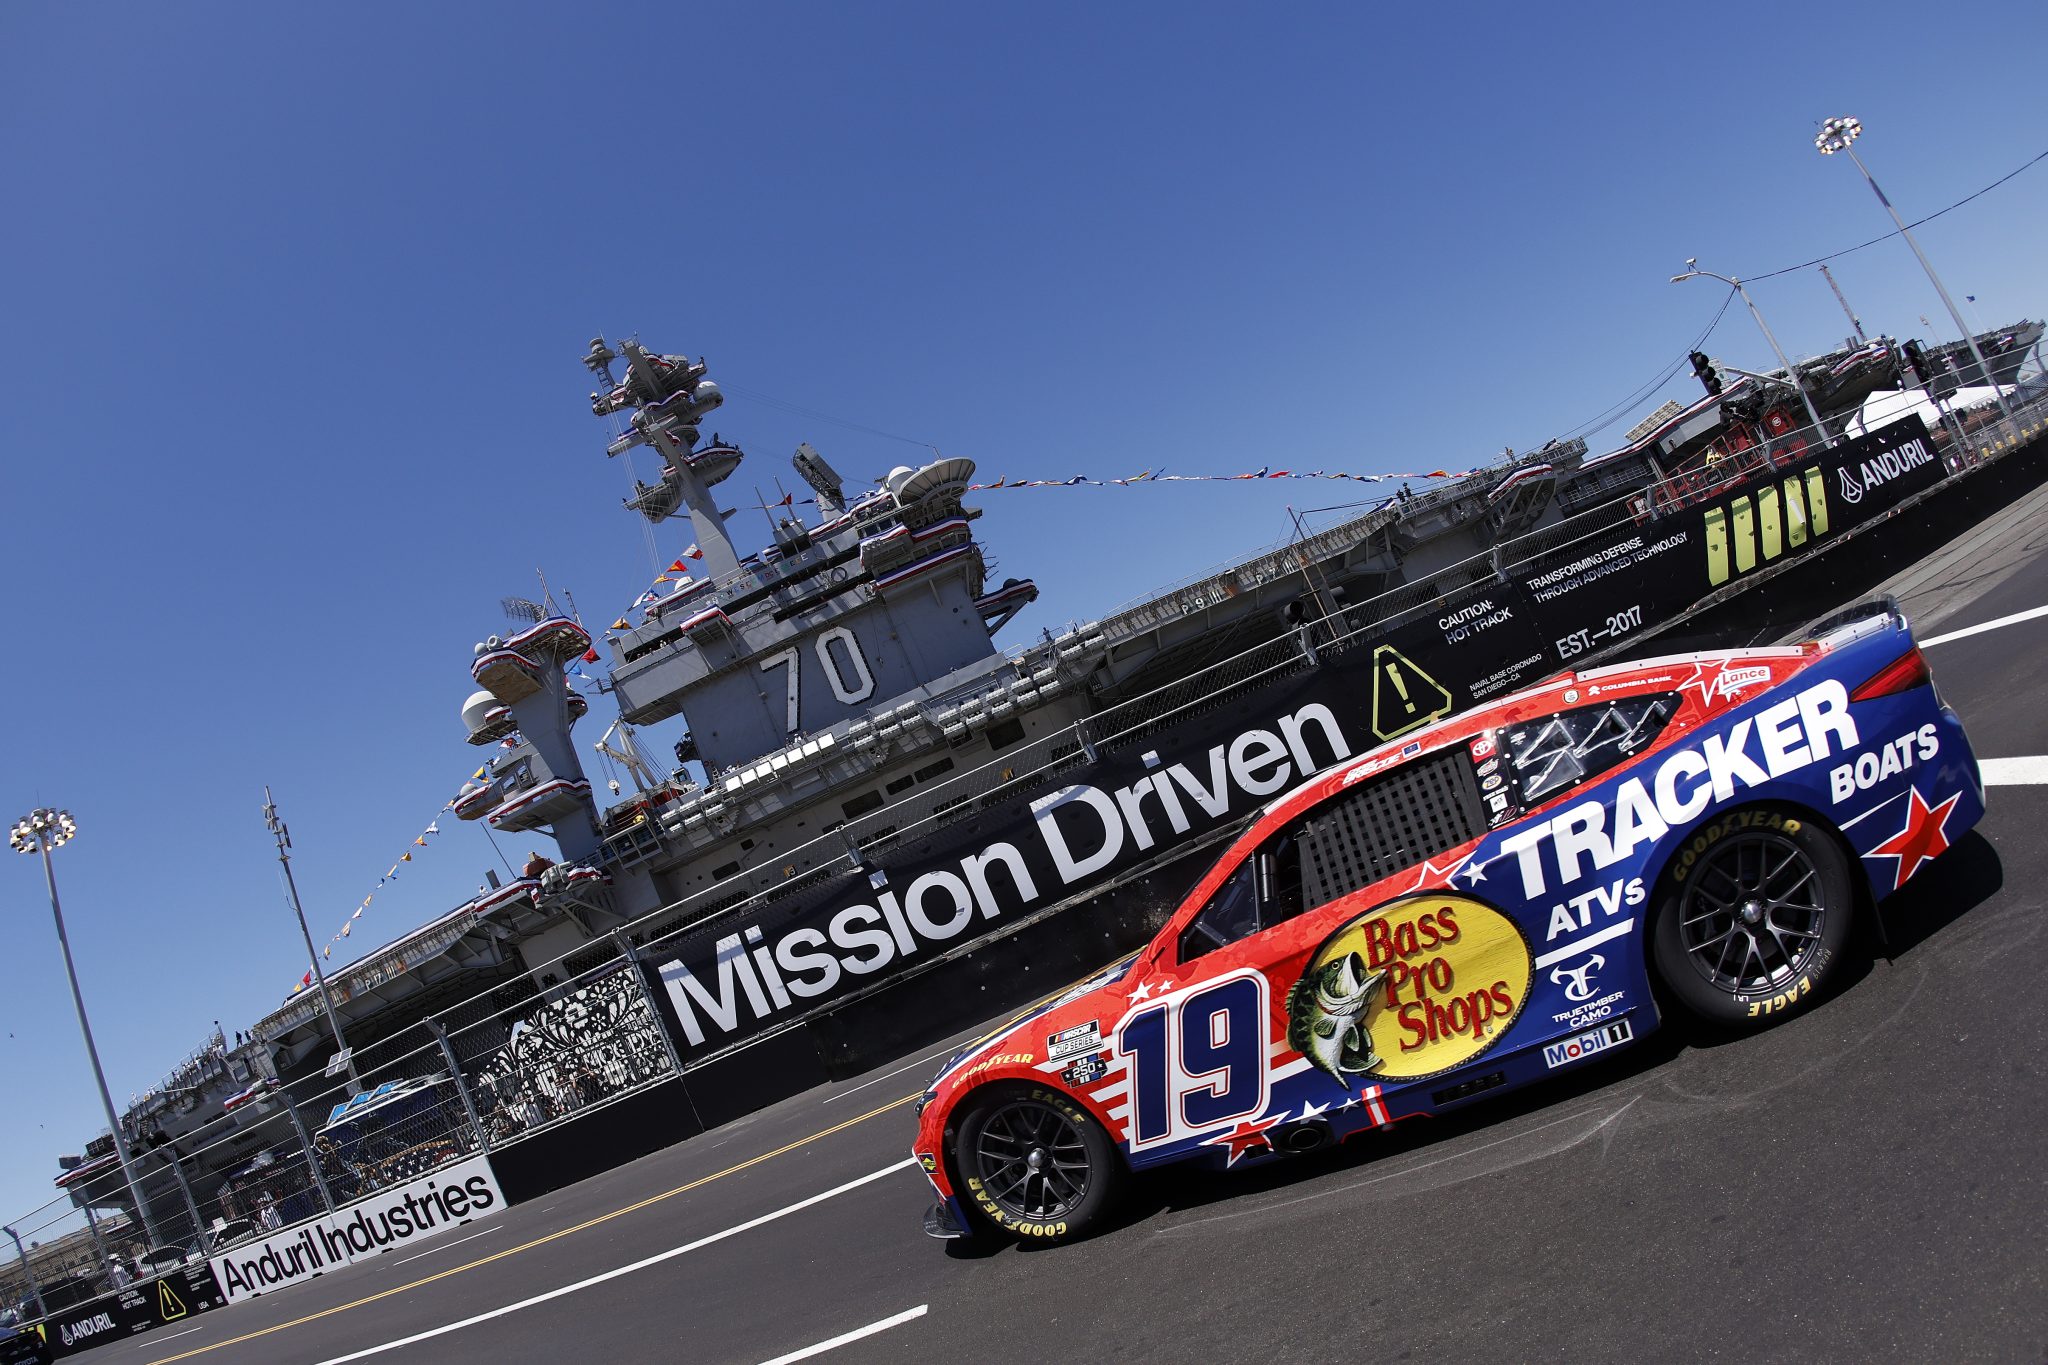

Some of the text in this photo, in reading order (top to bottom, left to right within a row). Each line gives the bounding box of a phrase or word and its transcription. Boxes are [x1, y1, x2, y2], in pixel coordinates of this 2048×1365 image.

[1860, 438, 1934, 491] ANDURIL
[1526, 537, 1644, 591] TRANSFORMING DEFENSE
[1533, 531, 1688, 604] THROUGH ADVANCED TECHNOLOGY
[1438, 599, 1495, 630] CAUTION:
[1445, 607, 1514, 645] HOT TRACK
[759, 626, 876, 733] 70
[1469, 653, 1542, 692] NAVAL BASE CORONADO
[1473, 687, 1487, 699] SAN
[1601, 675, 1672, 691] COLUMBIA BANK
[1722, 668, 1767, 686] Lance
[1829, 723, 1939, 804] BOATS
[1499, 678, 1860, 900] TRACKER
[1673, 811, 1801, 882] GOODYEAR
[657, 703, 1350, 1048] Mission Driven
[1546, 877, 1646, 942] ATVs
[1361, 906, 1460, 970] Bass
[1381, 957, 1452, 1009] Pro
[1748, 975, 1811, 1017] EAGLE
[1398, 981, 1513, 1051] Shops
[1552, 991, 1624, 1022] TRUETIMBER
[1570, 1005, 1612, 1028] CAMO
[1055, 1036, 1094, 1054] CUP SERIES
[1063, 1023, 1092, 1040] NASCAR
[1547, 1027, 1607, 1065] Mobil
[952, 1053, 1034, 1089] GOODYEAR
[1072, 1063, 1096, 1078] 250
[1121, 974, 1263, 1146] 19
[1031, 1089, 1085, 1124] EAGLE
[967, 1176, 1067, 1237] GOODYEAR
[221, 1175, 494, 1299] Anduril Industries
[72, 1312, 116, 1340] ANDURIL
